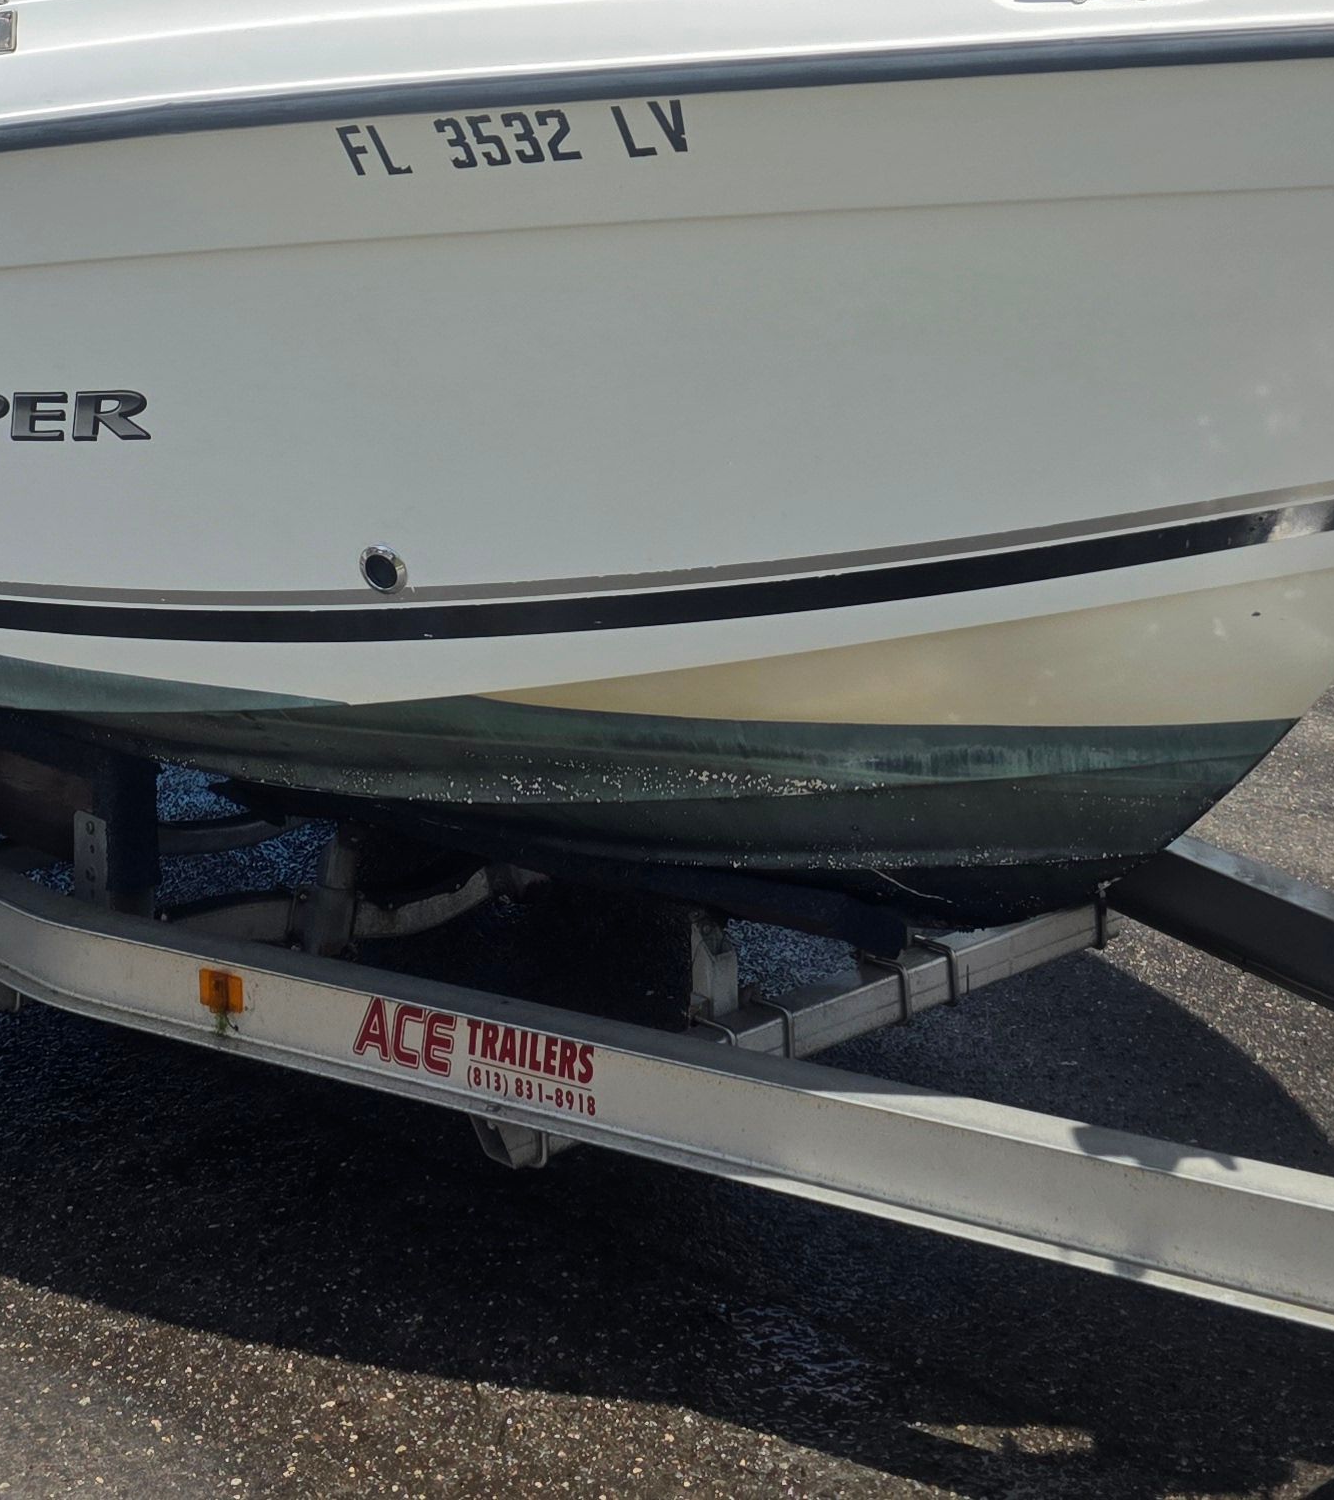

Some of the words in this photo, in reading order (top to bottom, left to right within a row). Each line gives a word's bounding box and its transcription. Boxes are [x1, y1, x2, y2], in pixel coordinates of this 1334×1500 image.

[336, 124, 413, 176] FL
[434, 109, 583, 169] 3532
[611, 99, 689, 158] LV
[353, 995, 457, 1078] ACE
[467, 1018, 595, 1085] TRAILERS
[467, 1065, 509, 1098] (813)
[515, 1077, 597, 1117] 831-8918
